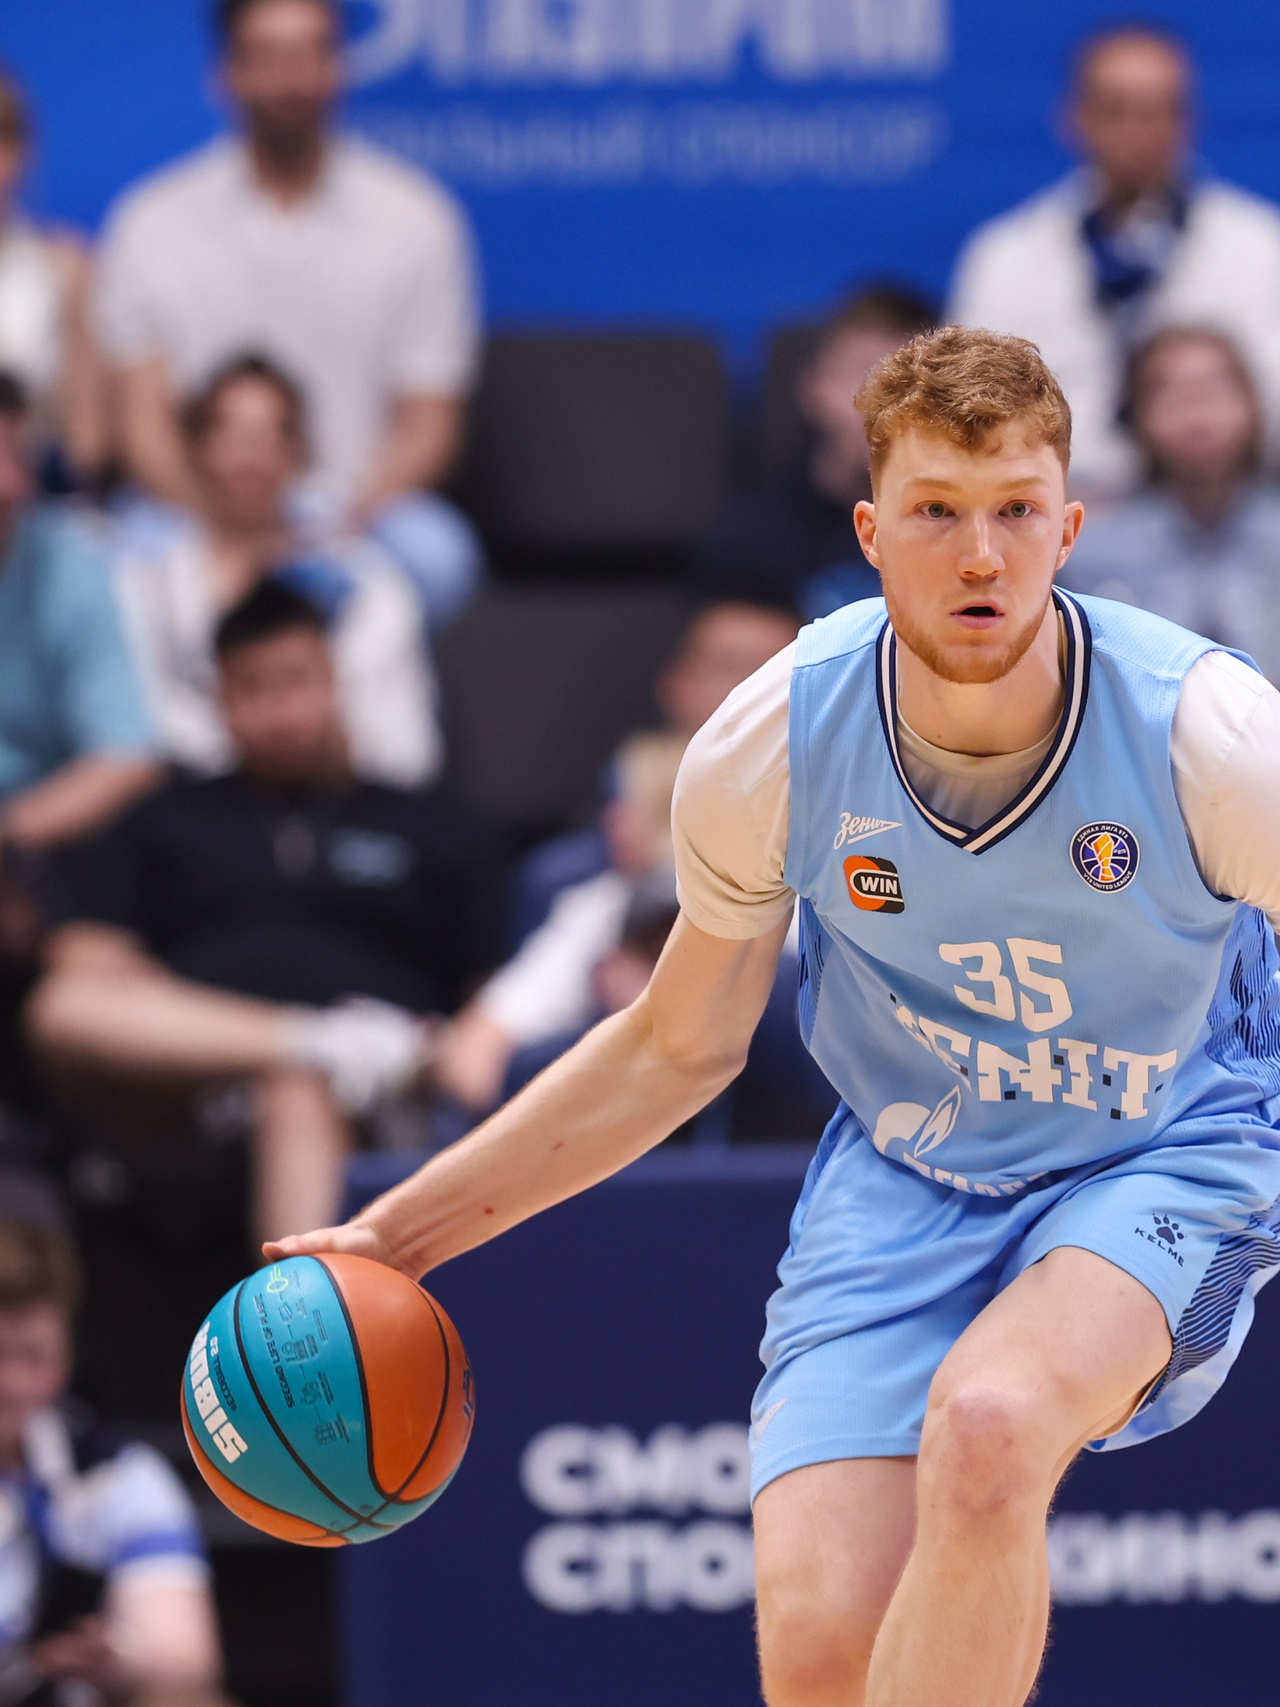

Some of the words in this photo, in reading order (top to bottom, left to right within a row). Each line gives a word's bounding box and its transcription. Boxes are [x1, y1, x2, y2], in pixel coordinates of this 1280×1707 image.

[860, 875, 898, 895] WIN
[938, 938, 1073, 1033] 35
[1134, 1227, 1185, 1268] KELME
[189, 1320, 249, 1464] SIBUR
[520, 1421, 752, 1515] СМО
[522, 1517, 755, 1614] СПО
